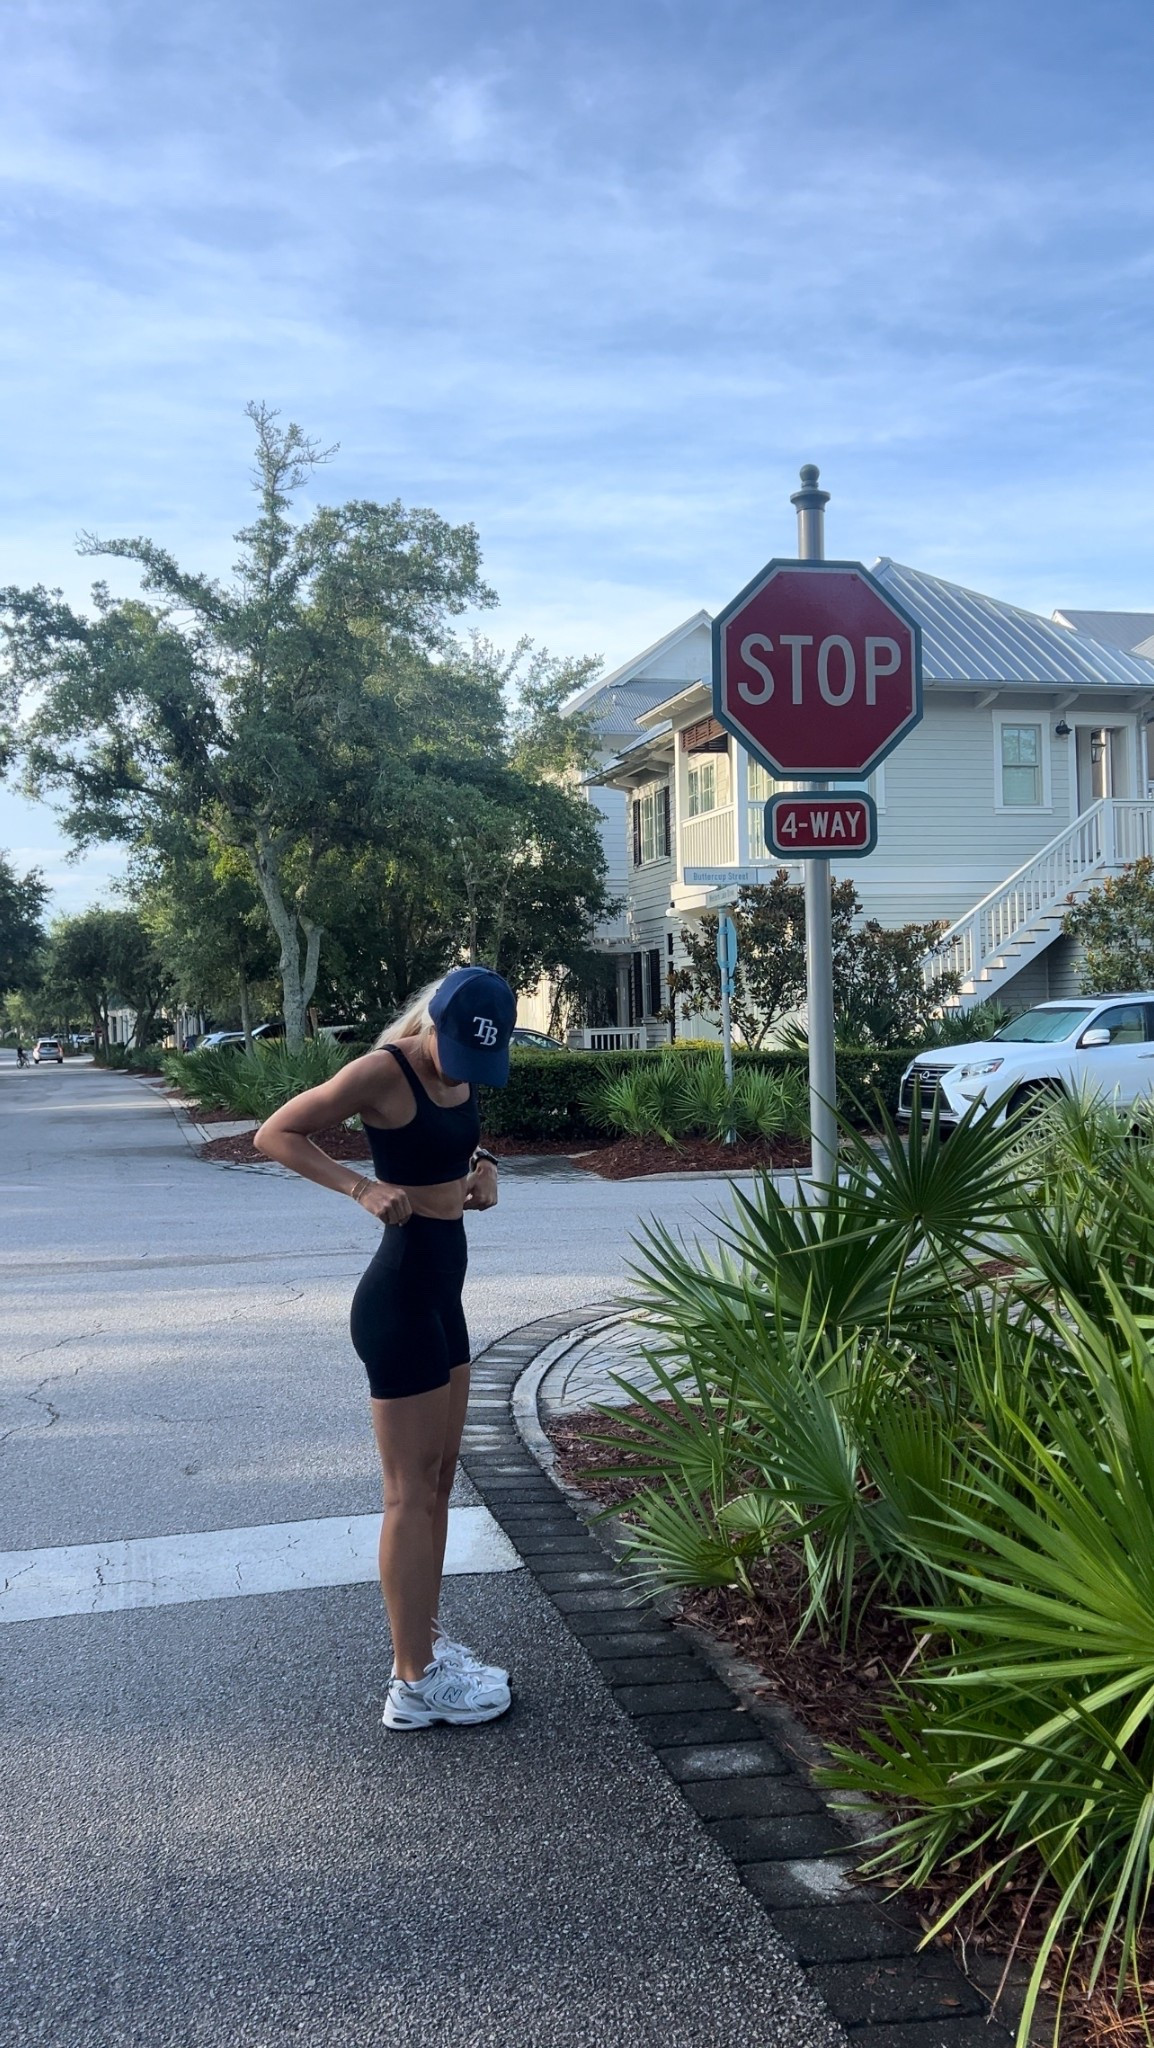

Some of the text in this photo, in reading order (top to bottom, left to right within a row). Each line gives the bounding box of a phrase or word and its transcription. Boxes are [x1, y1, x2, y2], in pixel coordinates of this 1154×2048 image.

[738, 633, 901, 706] STOP
[781, 811, 861, 838] 4-WAY
[693, 872, 749, 882] Buttercup Street
[472, 1016, 498, 1046] TB
[442, 1686, 462, 1704] N
